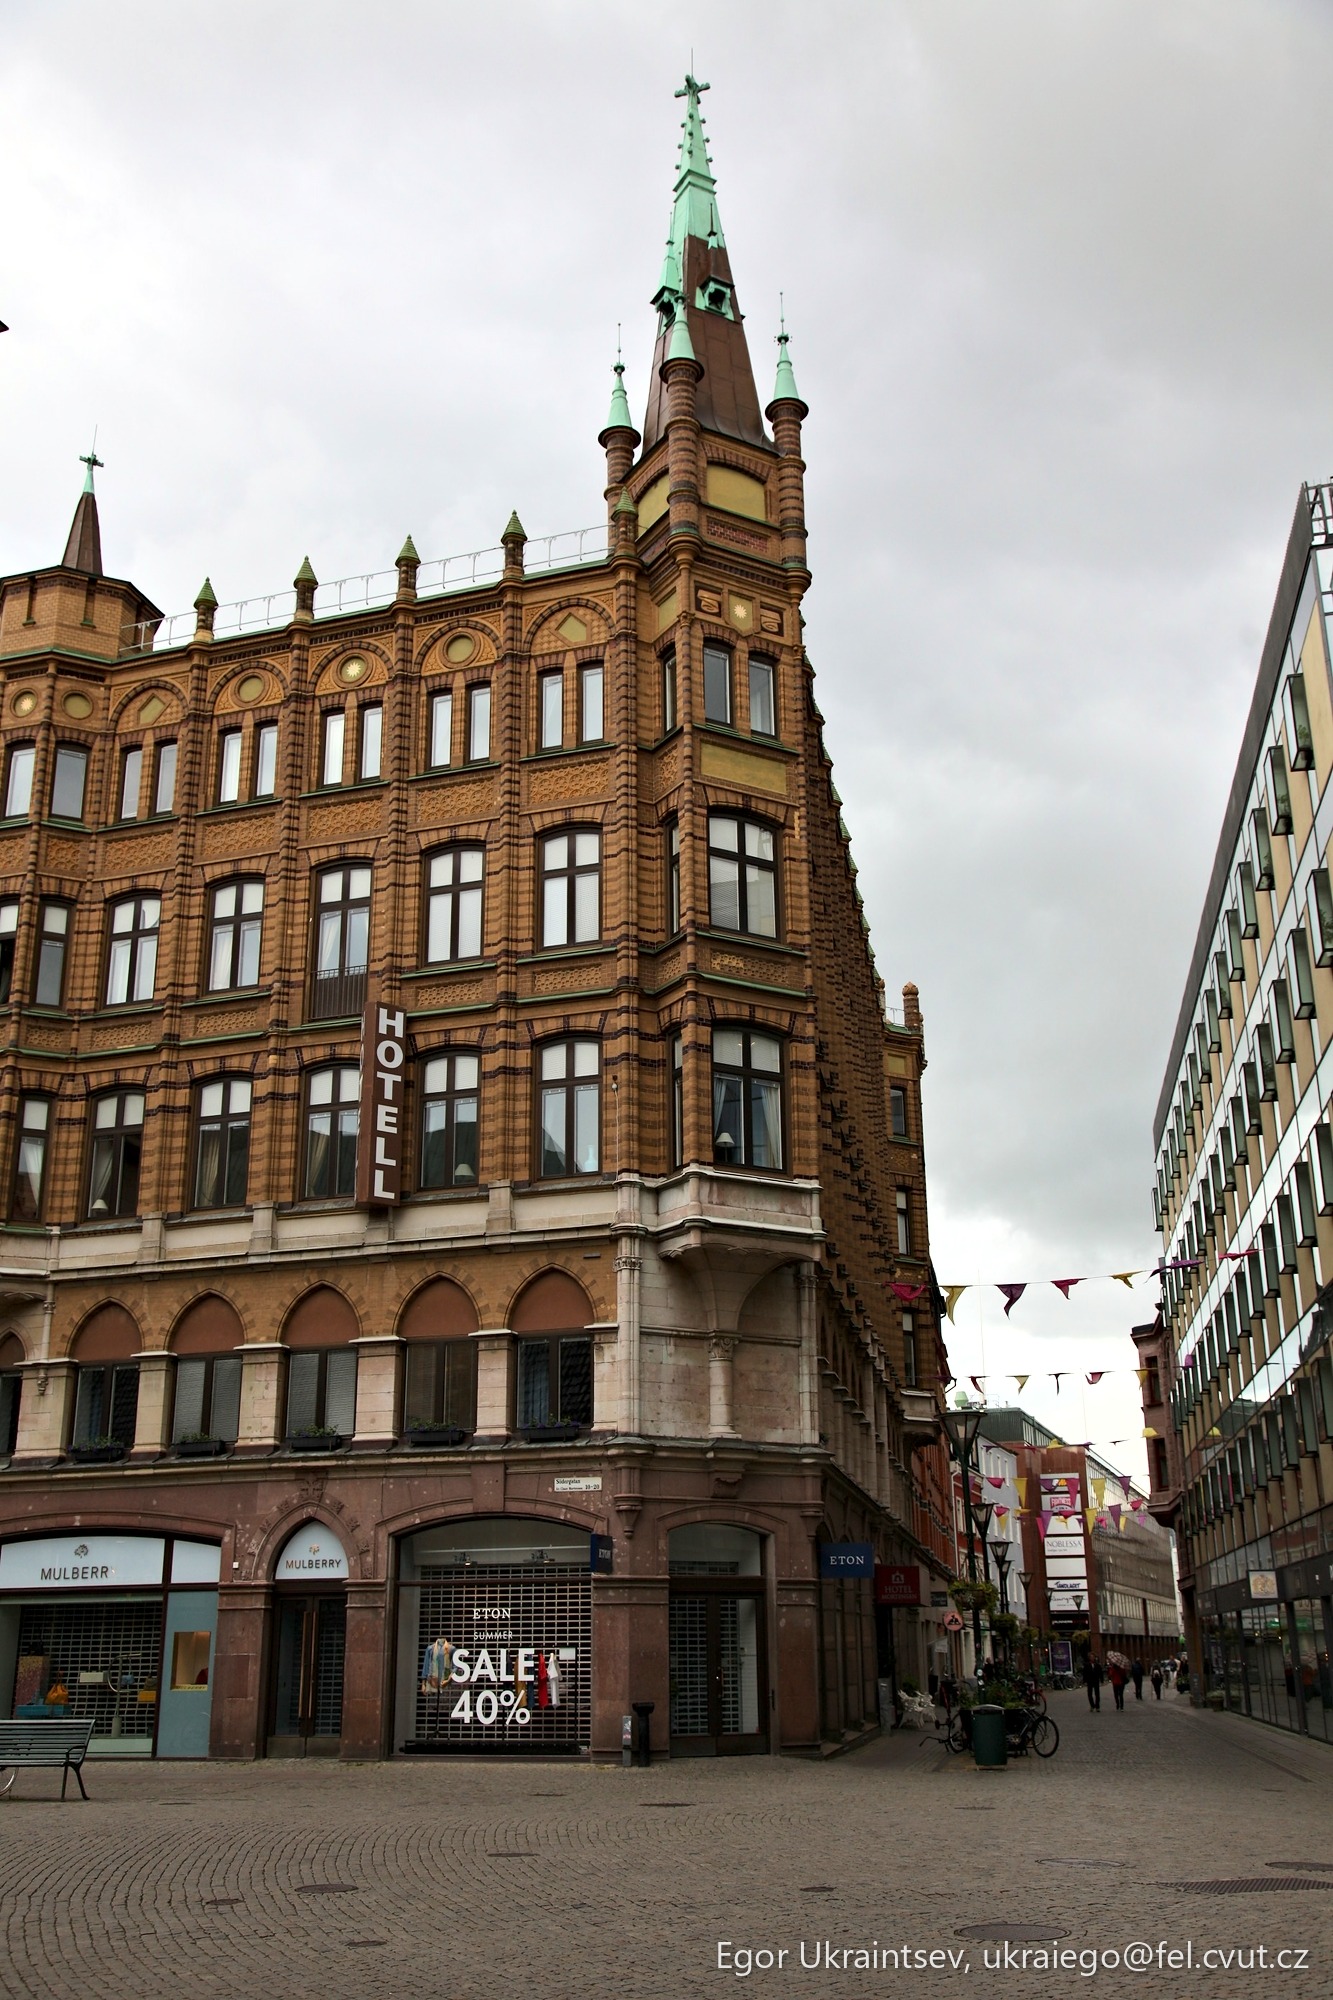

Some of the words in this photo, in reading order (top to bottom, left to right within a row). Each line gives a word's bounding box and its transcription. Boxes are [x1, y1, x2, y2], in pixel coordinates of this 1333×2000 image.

[373, 1007, 404, 1199] HOTELL
[1046, 1540, 1082, 1548] NOBLESSA
[285, 1558, 342, 1570] MULBERRY
[829, 1555, 864, 1565] ETON
[40, 1566, 116, 1581] MULBERR
[884, 1585, 912, 1594] HOTEL
[472, 1608, 511, 1619] ETON
[473, 1631, 513, 1640] SUMMER
[451, 1648, 535, 1682] SALE
[450, 1689, 531, 1725] 40%
